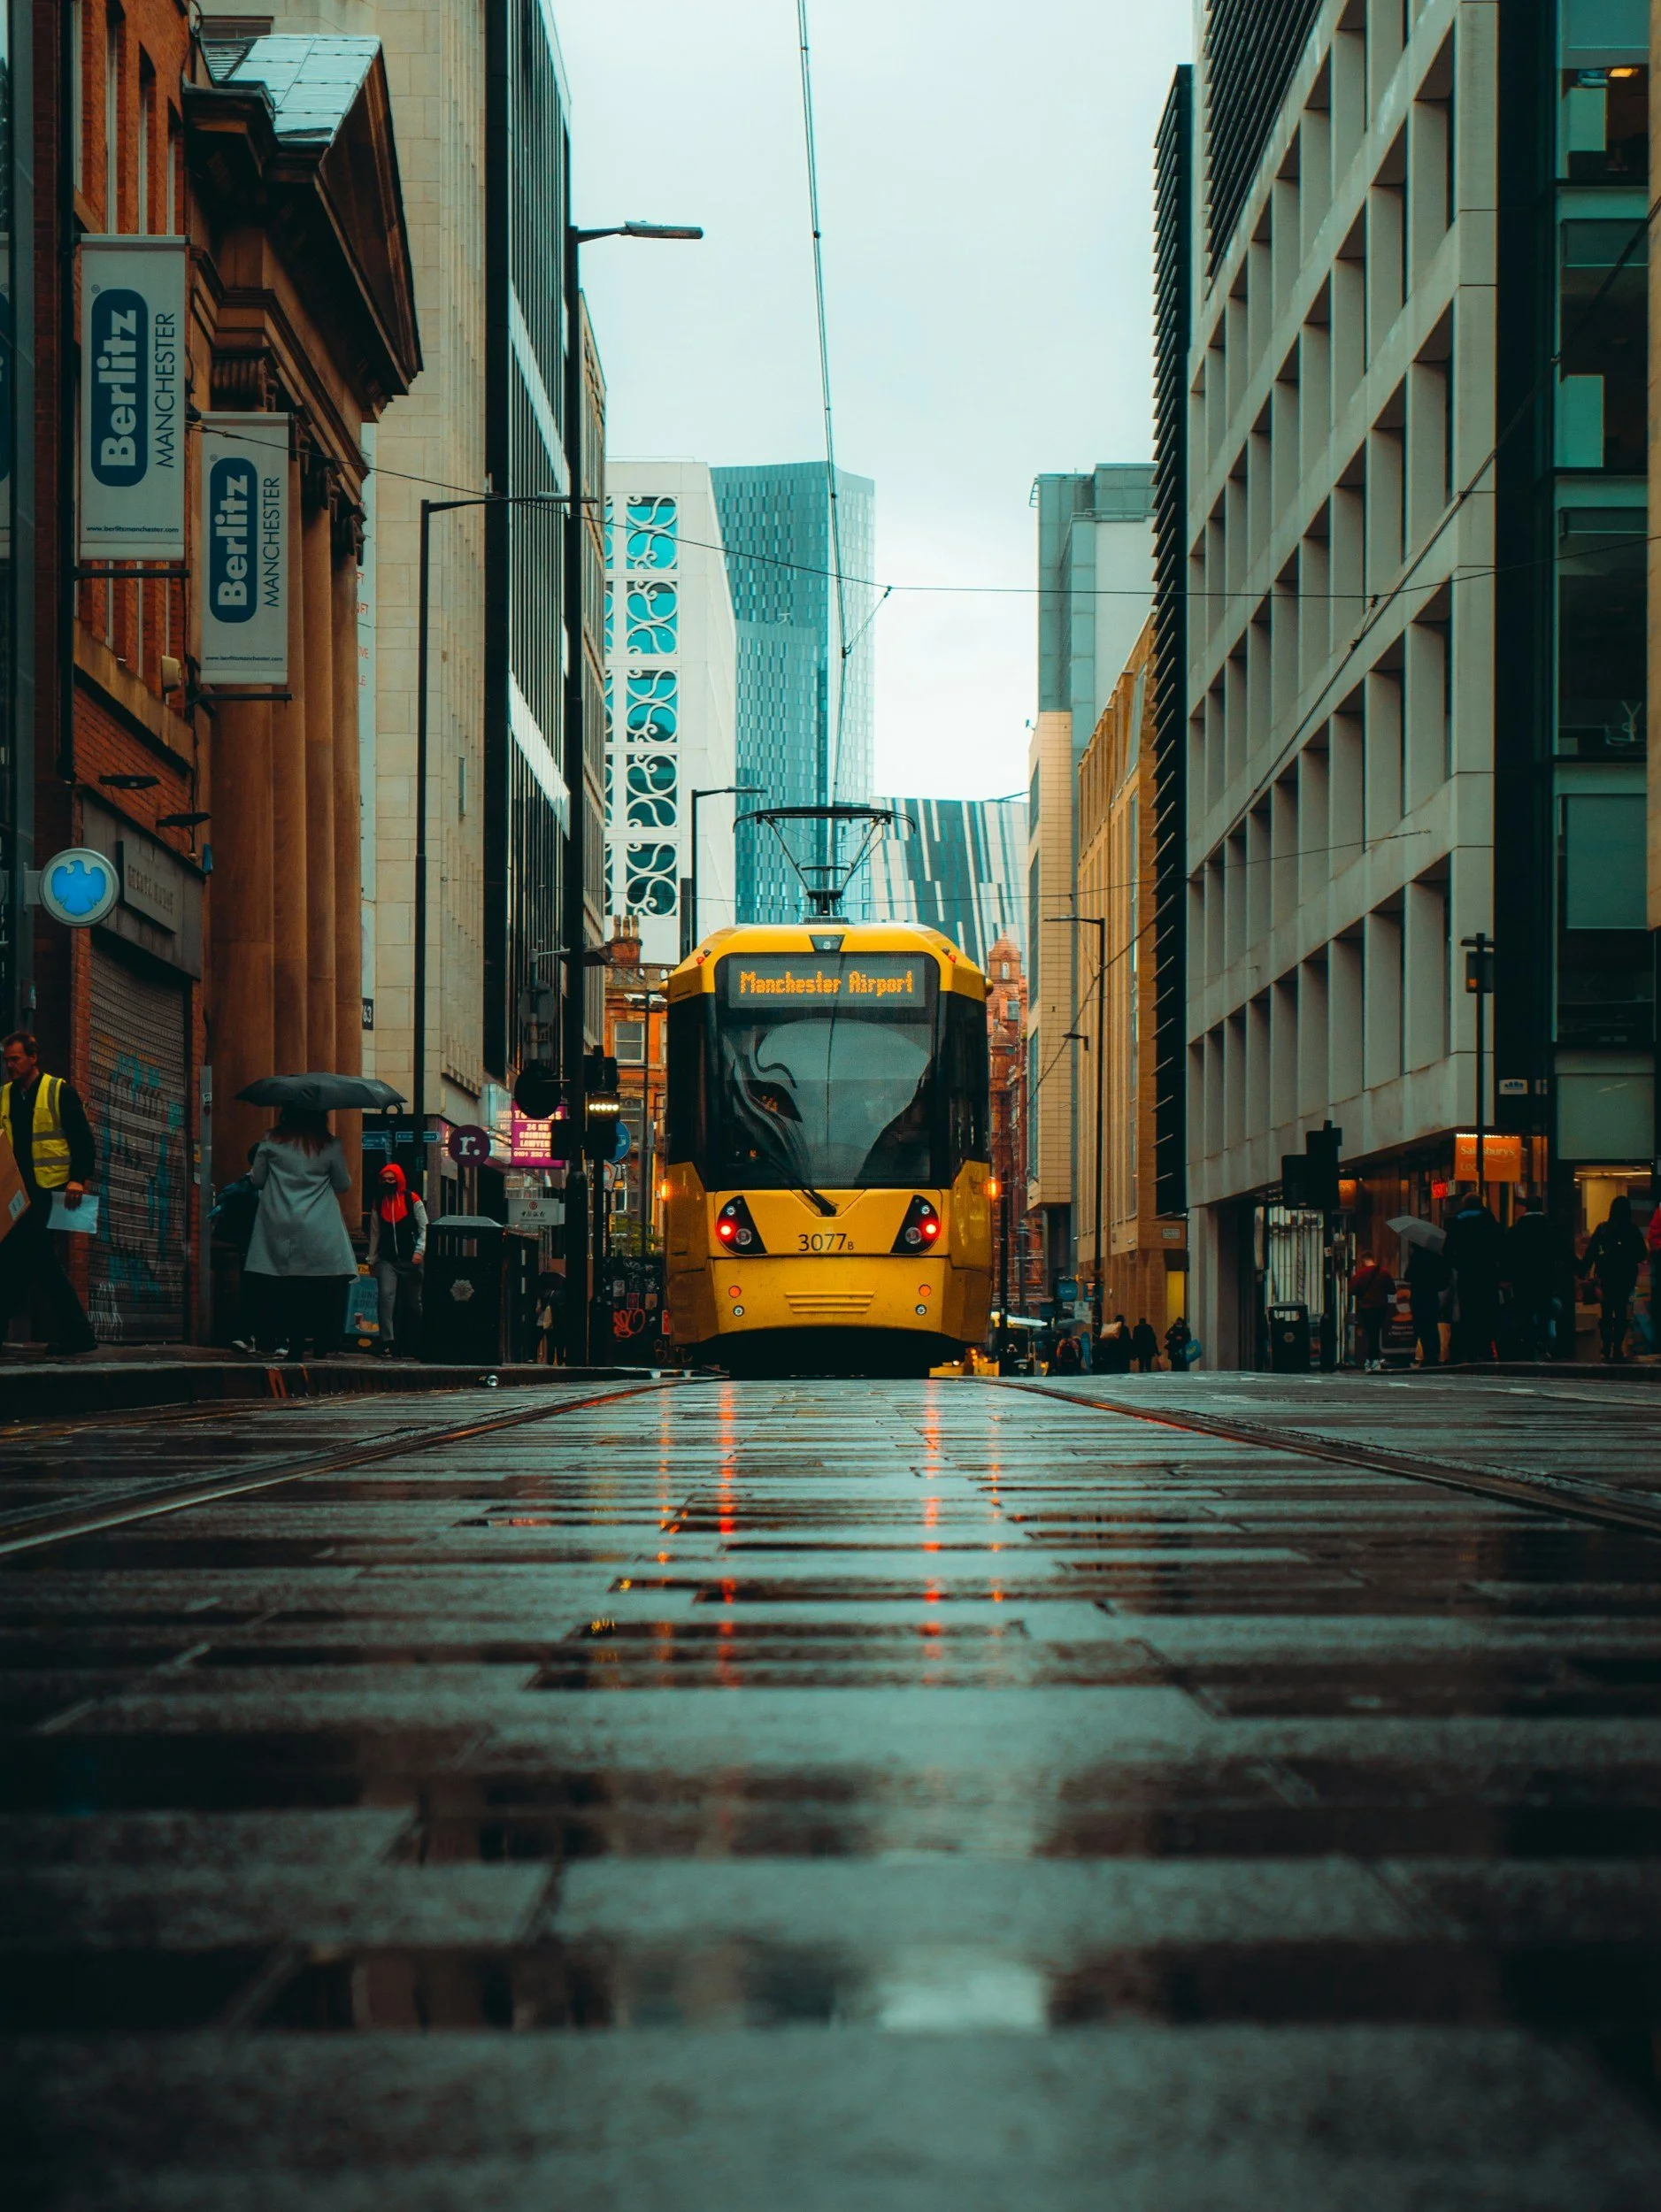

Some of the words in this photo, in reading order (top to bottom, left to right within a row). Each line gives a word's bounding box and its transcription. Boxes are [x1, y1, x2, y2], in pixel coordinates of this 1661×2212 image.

[96, 309, 136, 468] Berlitz
[155, 312, 175, 468] MANCHESTER
[215, 474, 249, 607] Berlitz
[264, 476, 281, 609] MANCHESTER
[740, 971, 842, 995] Manchester
[849, 971, 914, 997] Airport
